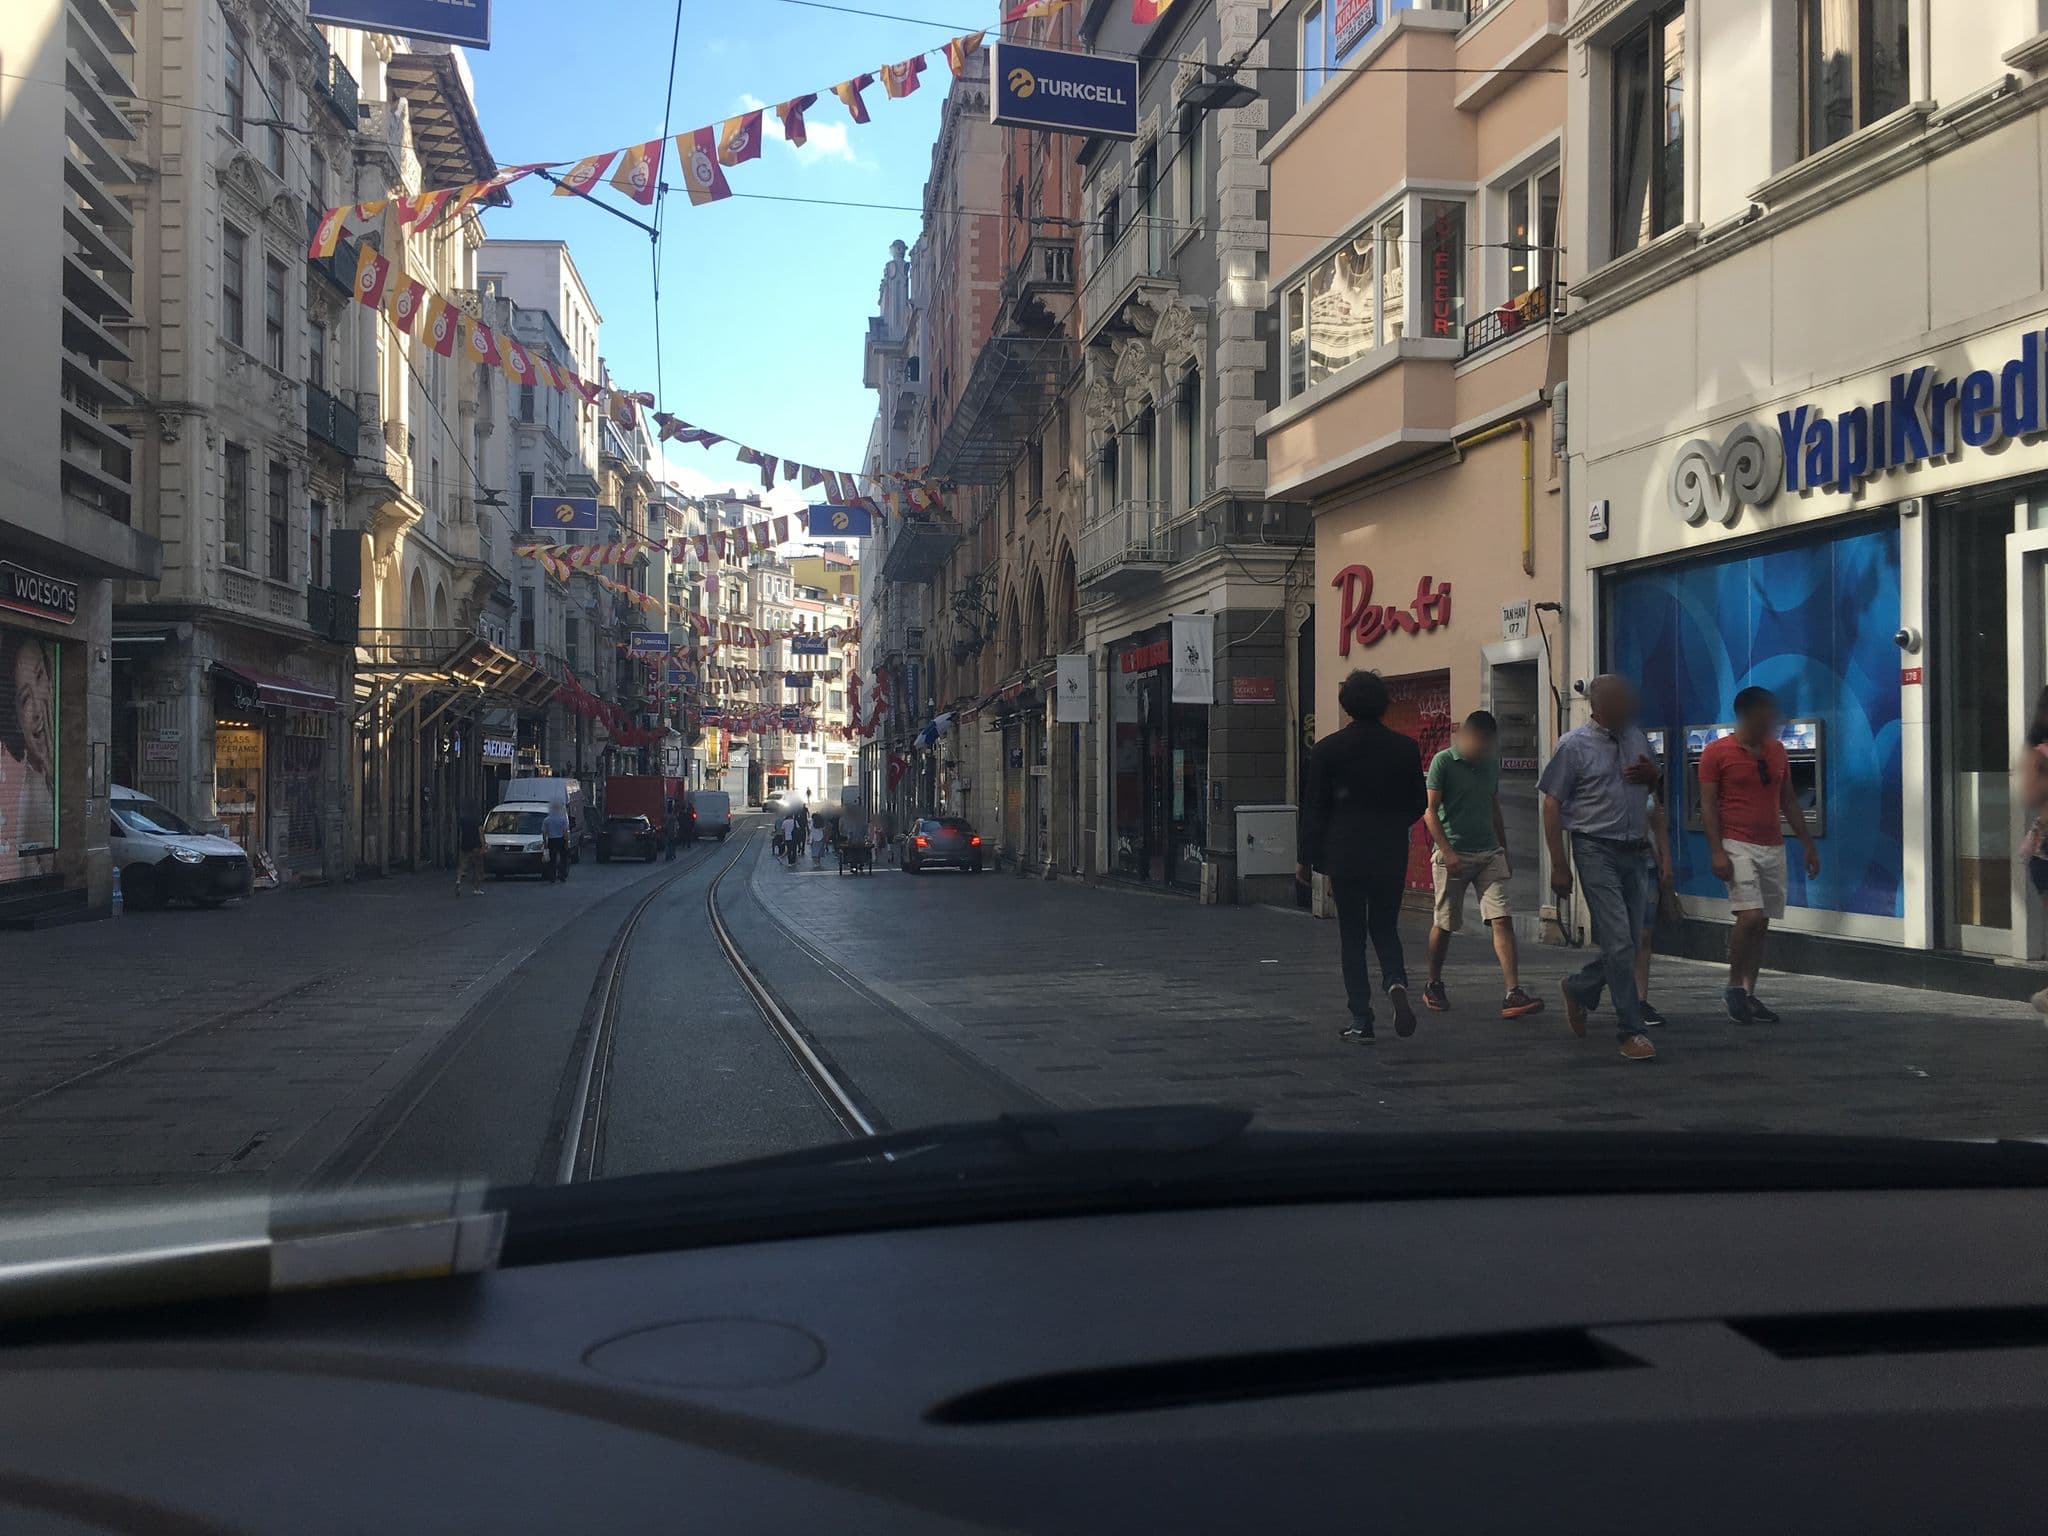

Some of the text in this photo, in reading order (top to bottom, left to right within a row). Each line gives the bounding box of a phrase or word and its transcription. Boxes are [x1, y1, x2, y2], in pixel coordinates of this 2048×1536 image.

[1038, 77, 1127, 105] TURKCELL
[1433, 203, 1451, 336] COIFFEUR
[1777, 326, 2048, 494] YapıKred
[14, 571, 76, 612] watsons
[1331, 564, 1452, 657] Penti
[1503, 609, 1513, 621] TAN
[1509, 622, 1520, 633] 177
[221, 744, 259, 753] CERAMIC
[222, 735, 250, 744] GLASS
